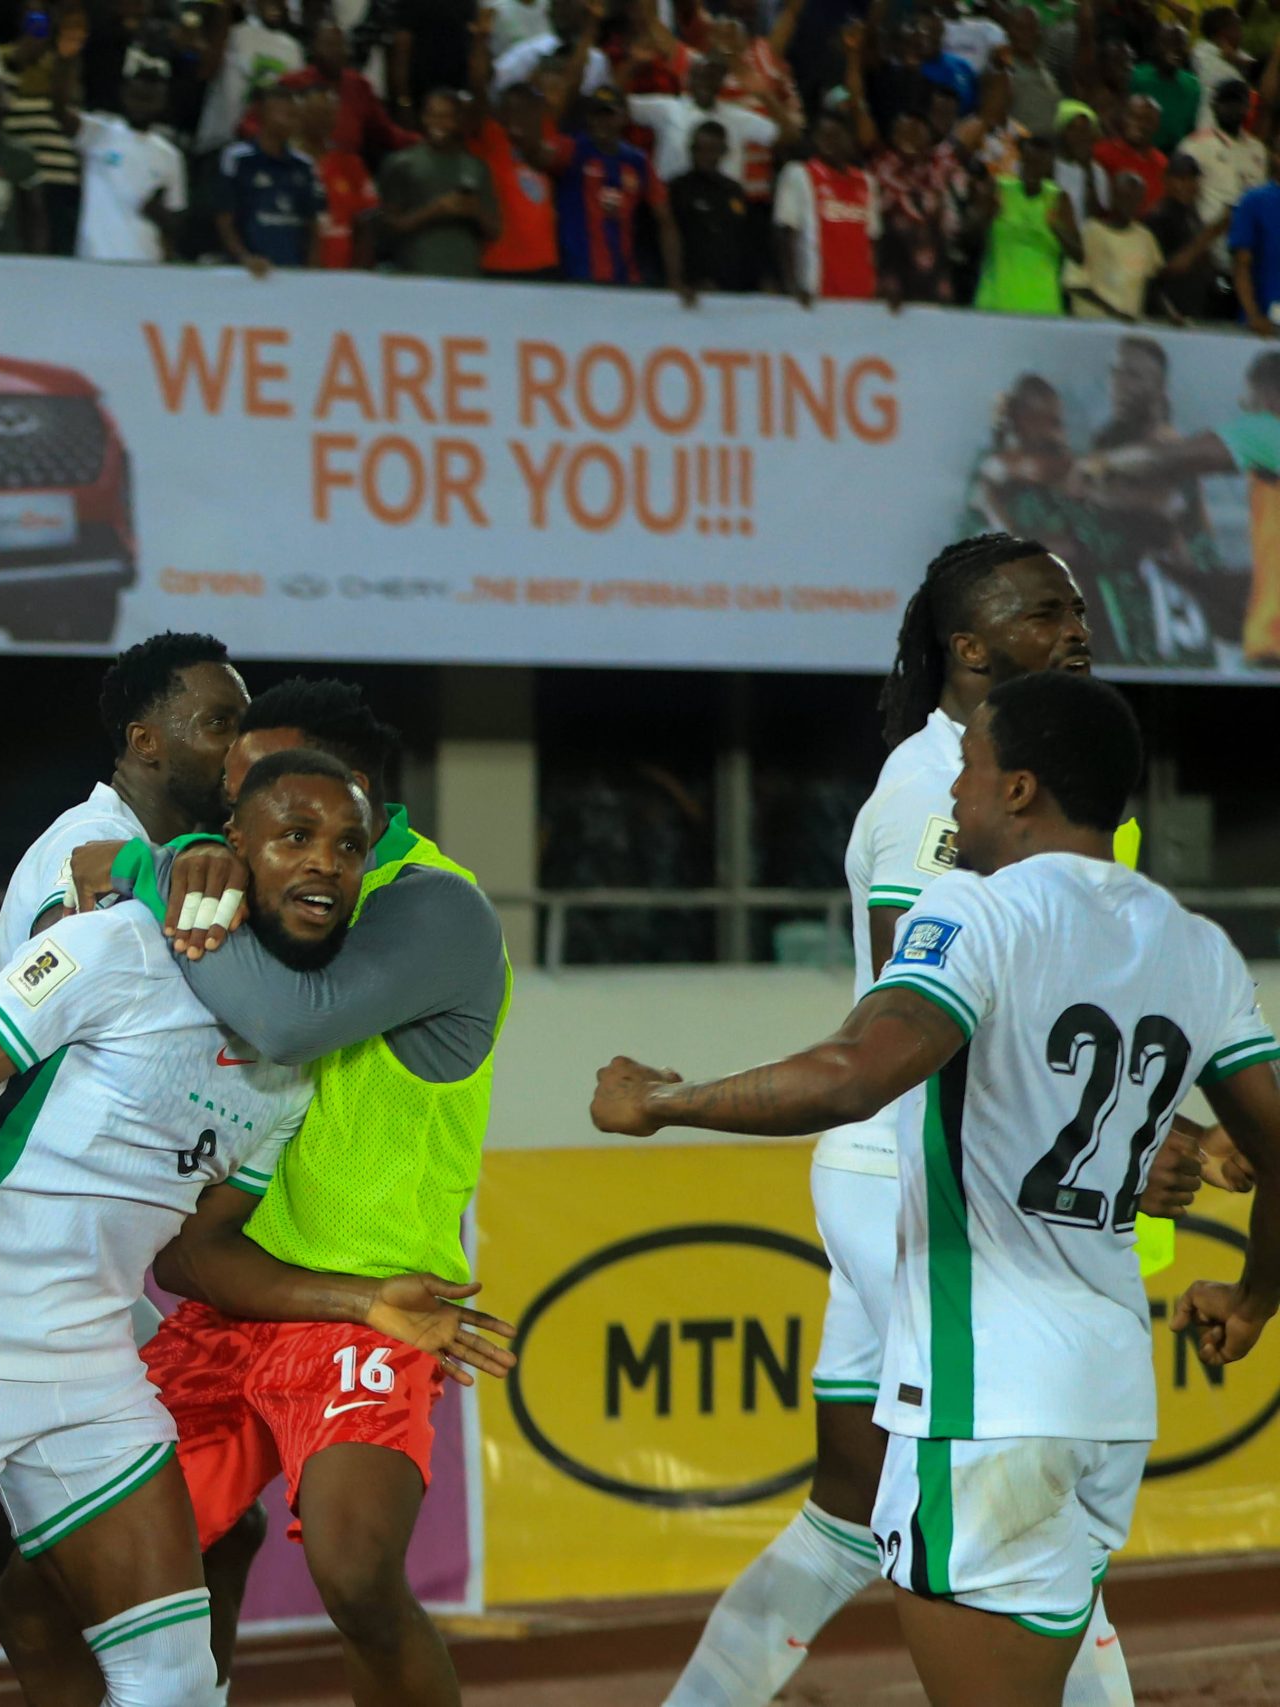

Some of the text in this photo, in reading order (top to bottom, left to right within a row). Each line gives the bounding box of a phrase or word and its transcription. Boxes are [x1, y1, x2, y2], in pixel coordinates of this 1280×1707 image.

[142, 320, 899, 445] WE ARE ROOTING
[311, 432, 755, 539] FOR YOU!!!
[1017, 1003, 1192, 1234] 22
[333, 1345, 395, 1394] 16
[605, 1315, 802, 1419] MTN
